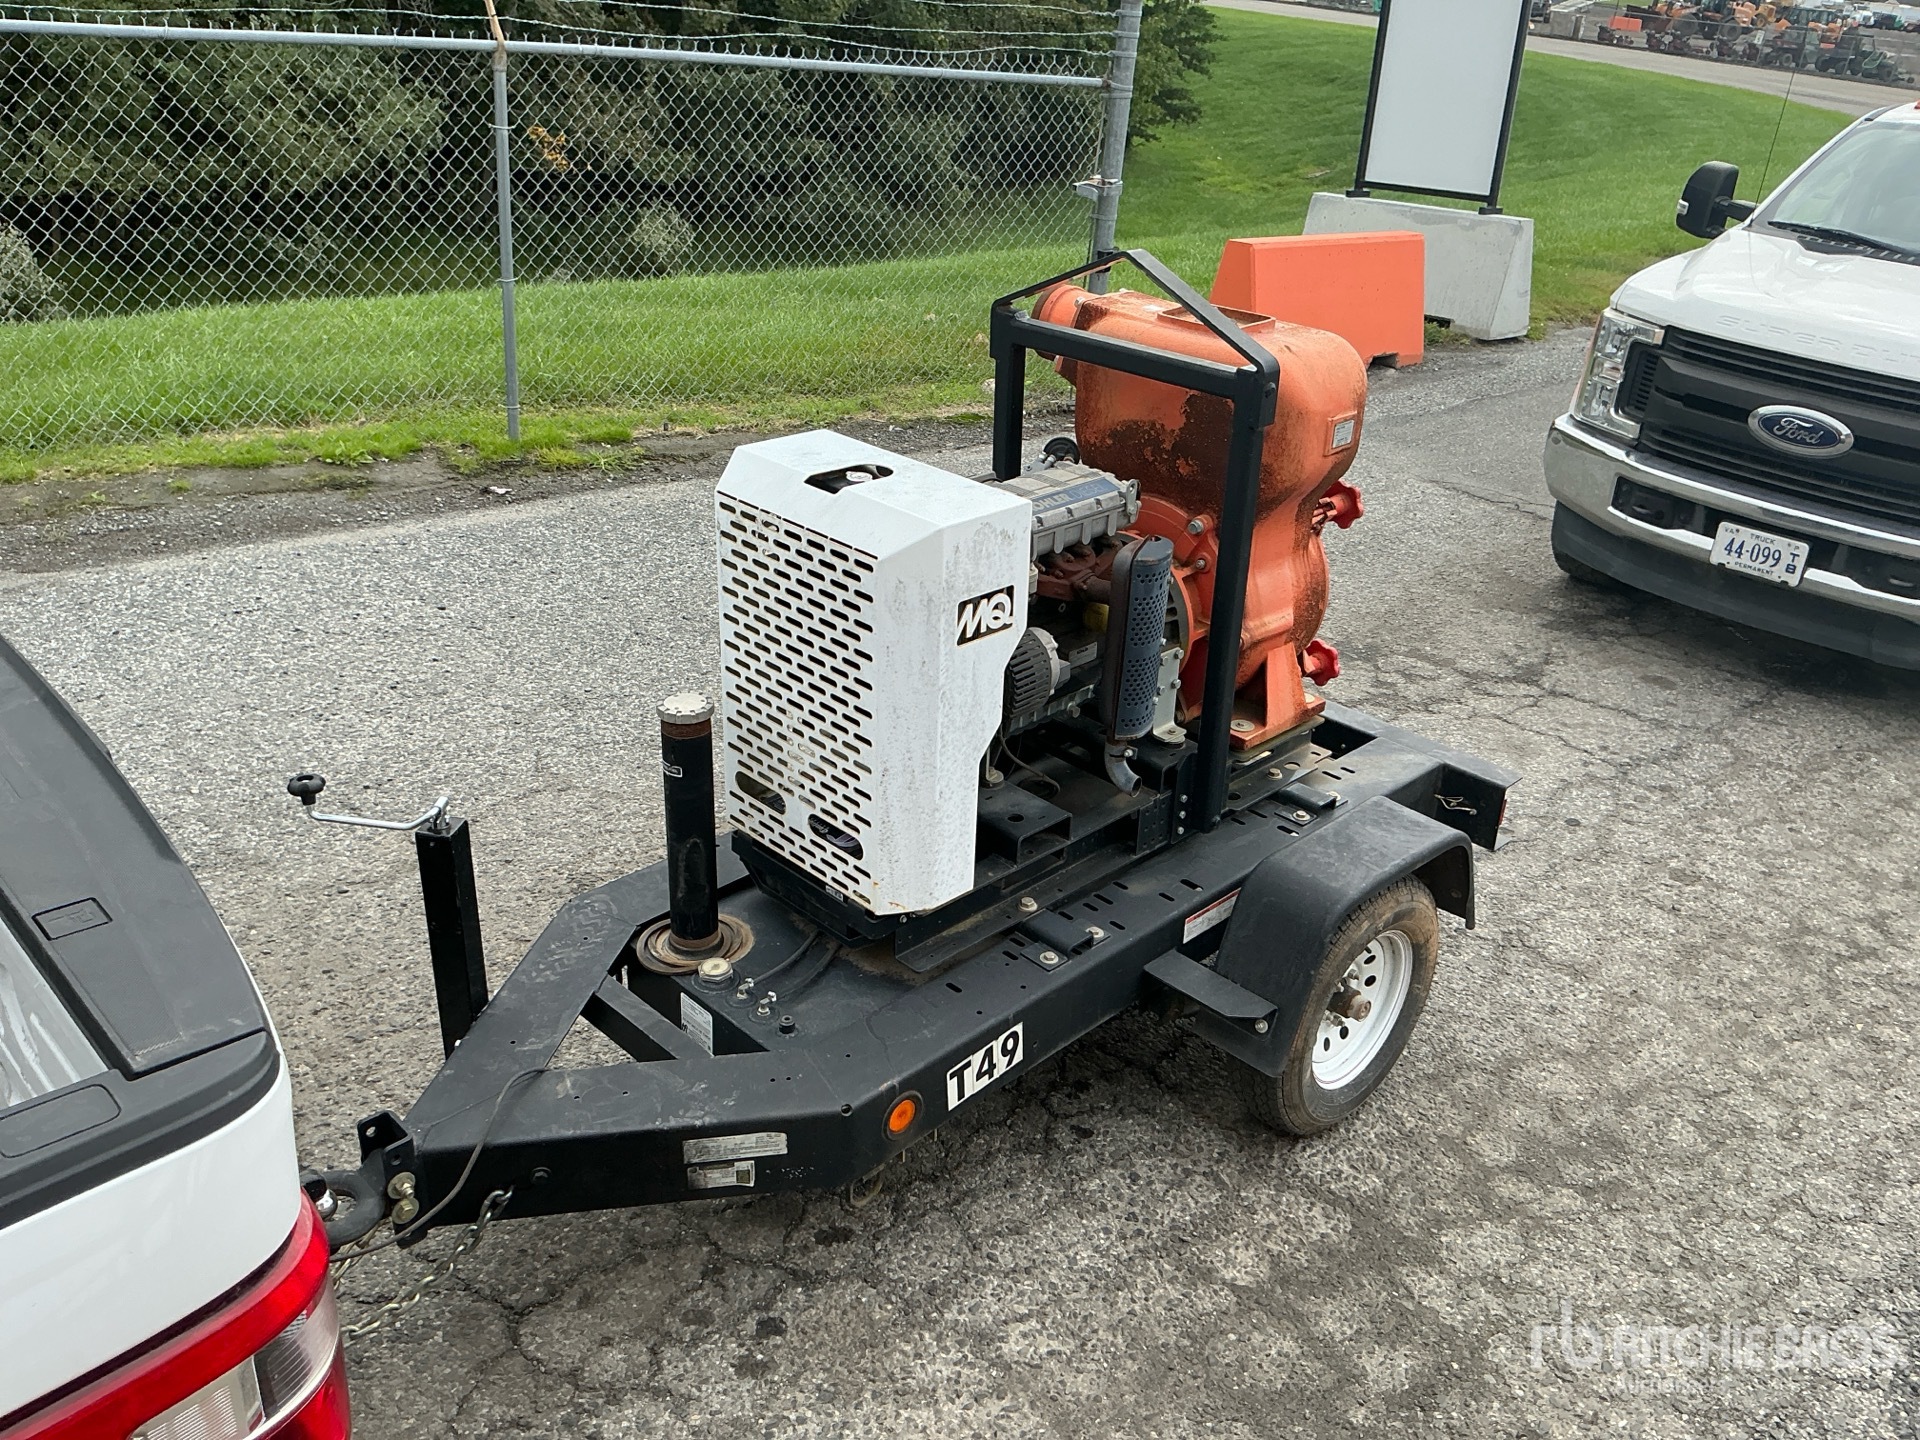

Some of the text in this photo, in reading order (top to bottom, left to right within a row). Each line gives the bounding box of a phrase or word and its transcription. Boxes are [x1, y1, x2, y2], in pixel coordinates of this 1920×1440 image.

[1715, 315, 1920, 364] SUPER DU
[1773, 417, 1824, 444] Ford
[1032, 493, 1073, 511] OHLER
[1724, 537, 1781, 568] 44-099
[1750, 533, 1776, 545] TRUCK
[1734, 561, 1774, 576] PERMANENT
[957, 593, 1014, 639] MQ
[949, 1030, 1020, 1102] T49
